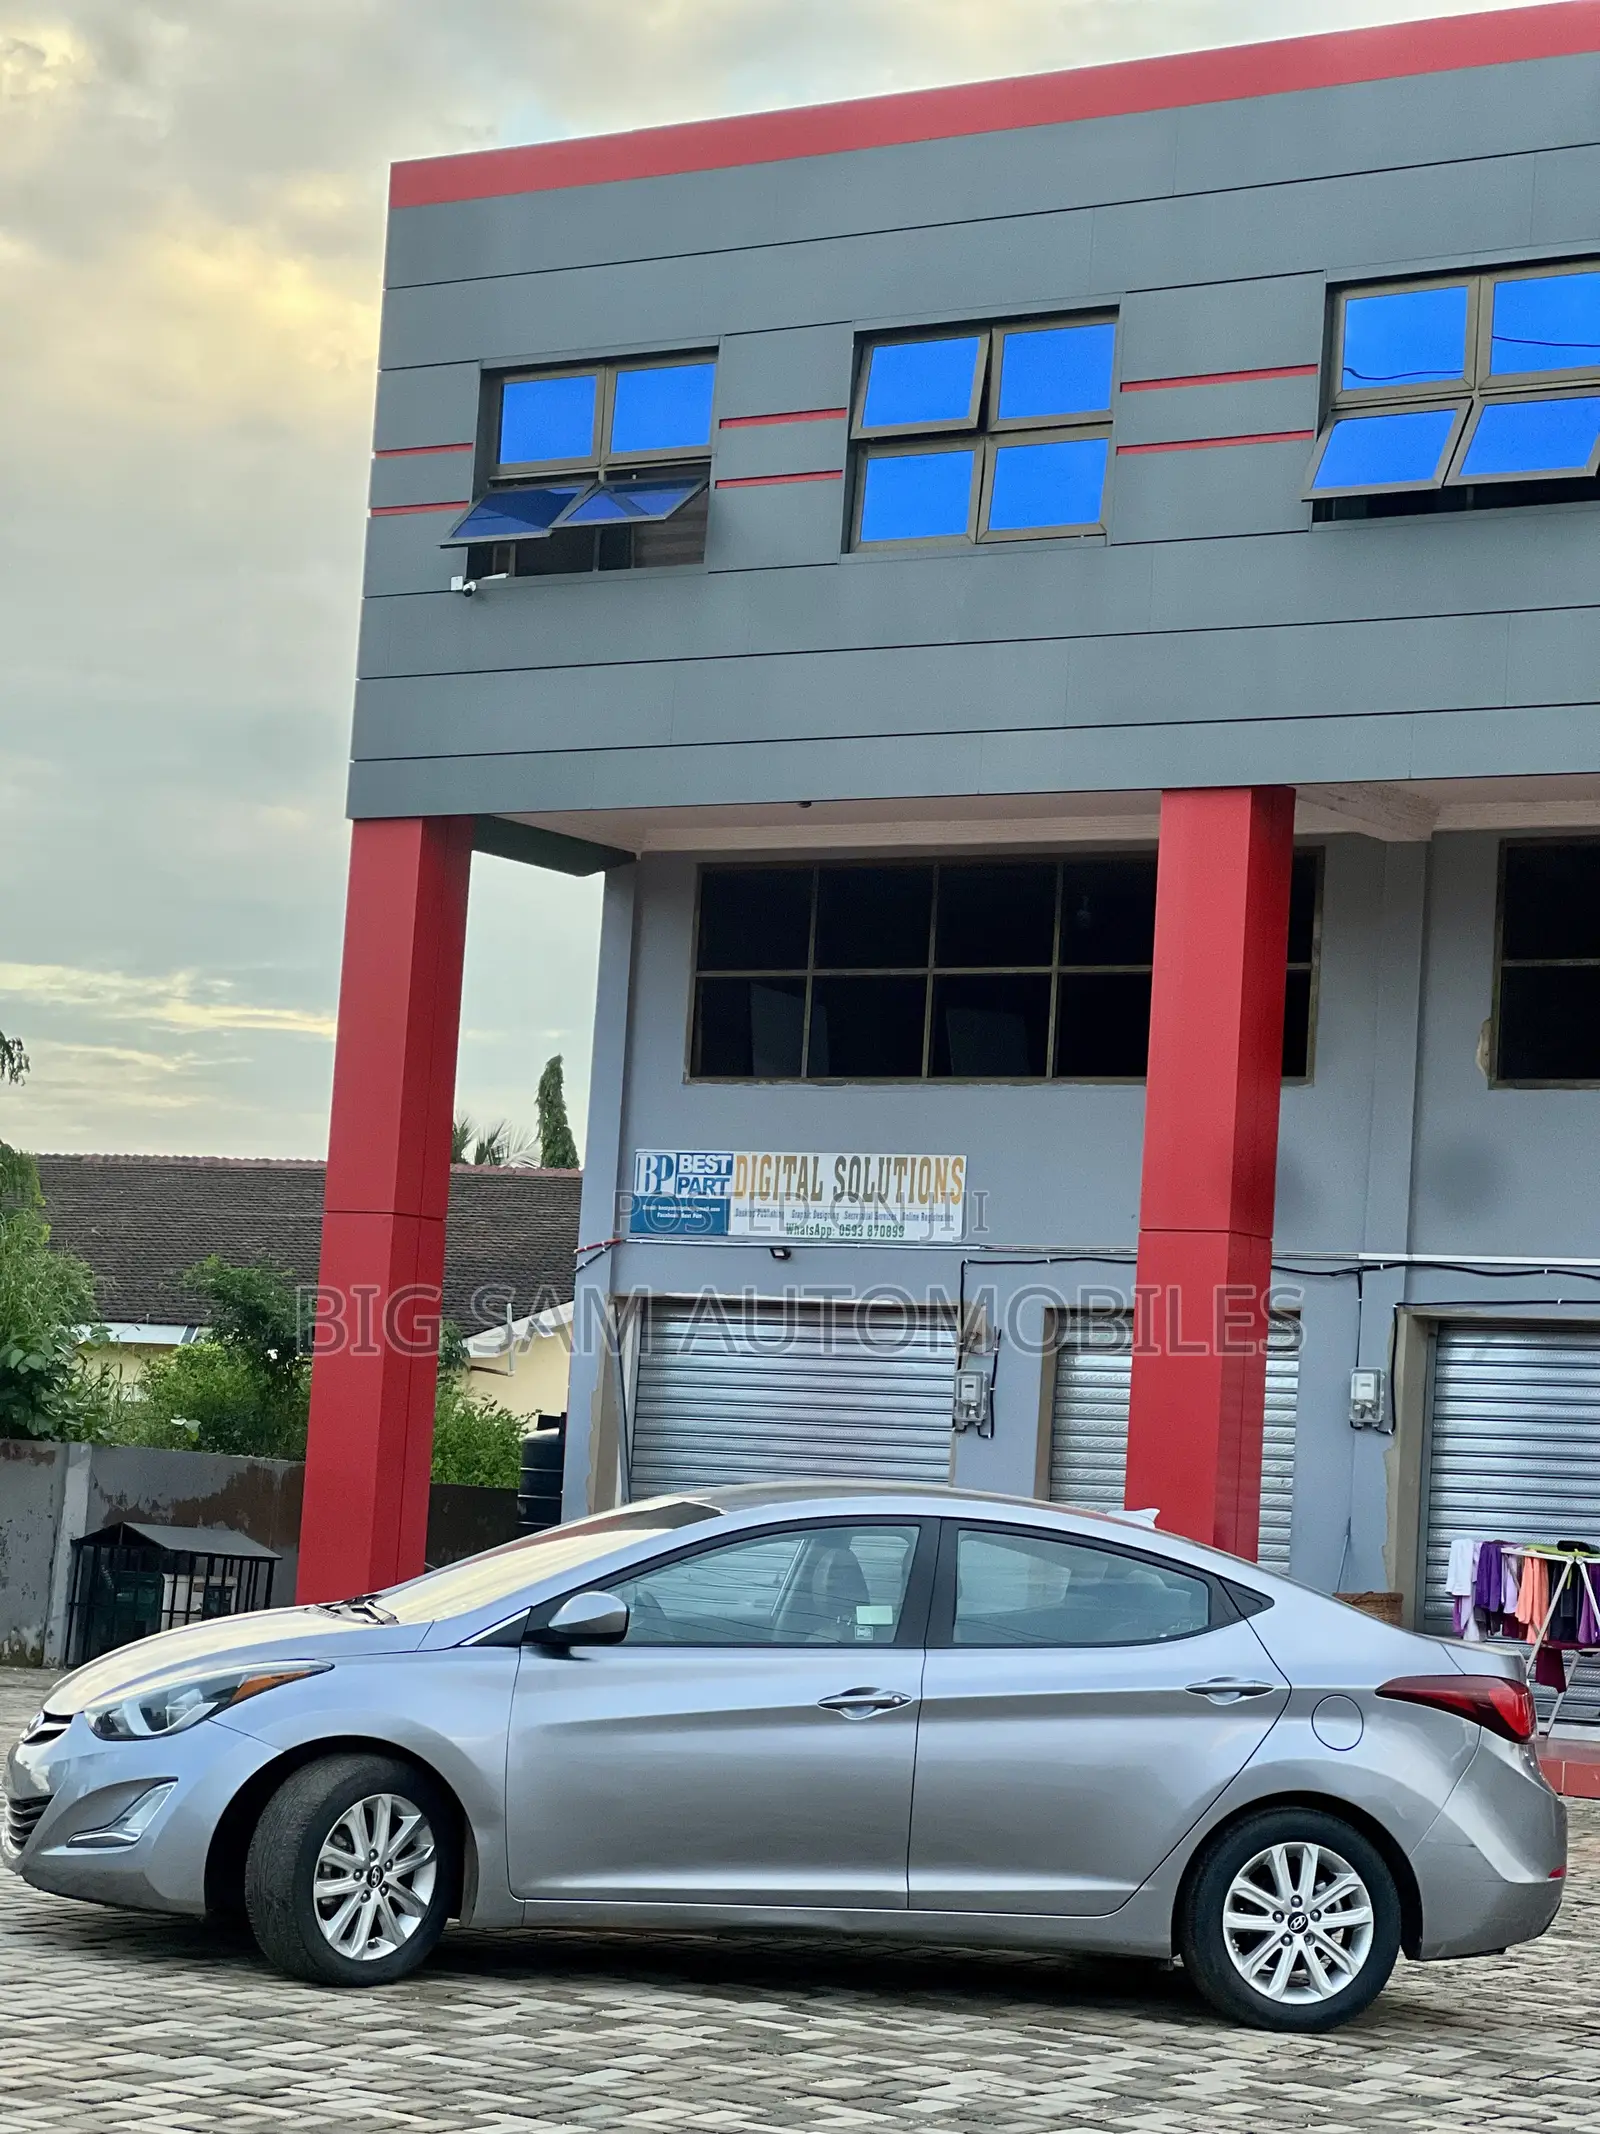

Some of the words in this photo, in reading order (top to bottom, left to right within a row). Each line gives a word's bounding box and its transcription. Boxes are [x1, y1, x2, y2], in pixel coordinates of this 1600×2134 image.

[678, 1154, 732, 1174] BEST
[677, 1176, 731, 1196] PART
[735, 1154, 824, 1202] DIGITAL
[833, 1155, 965, 1205] SOLUTIONS
[786, 1222, 835, 1239] WhatsApp:
